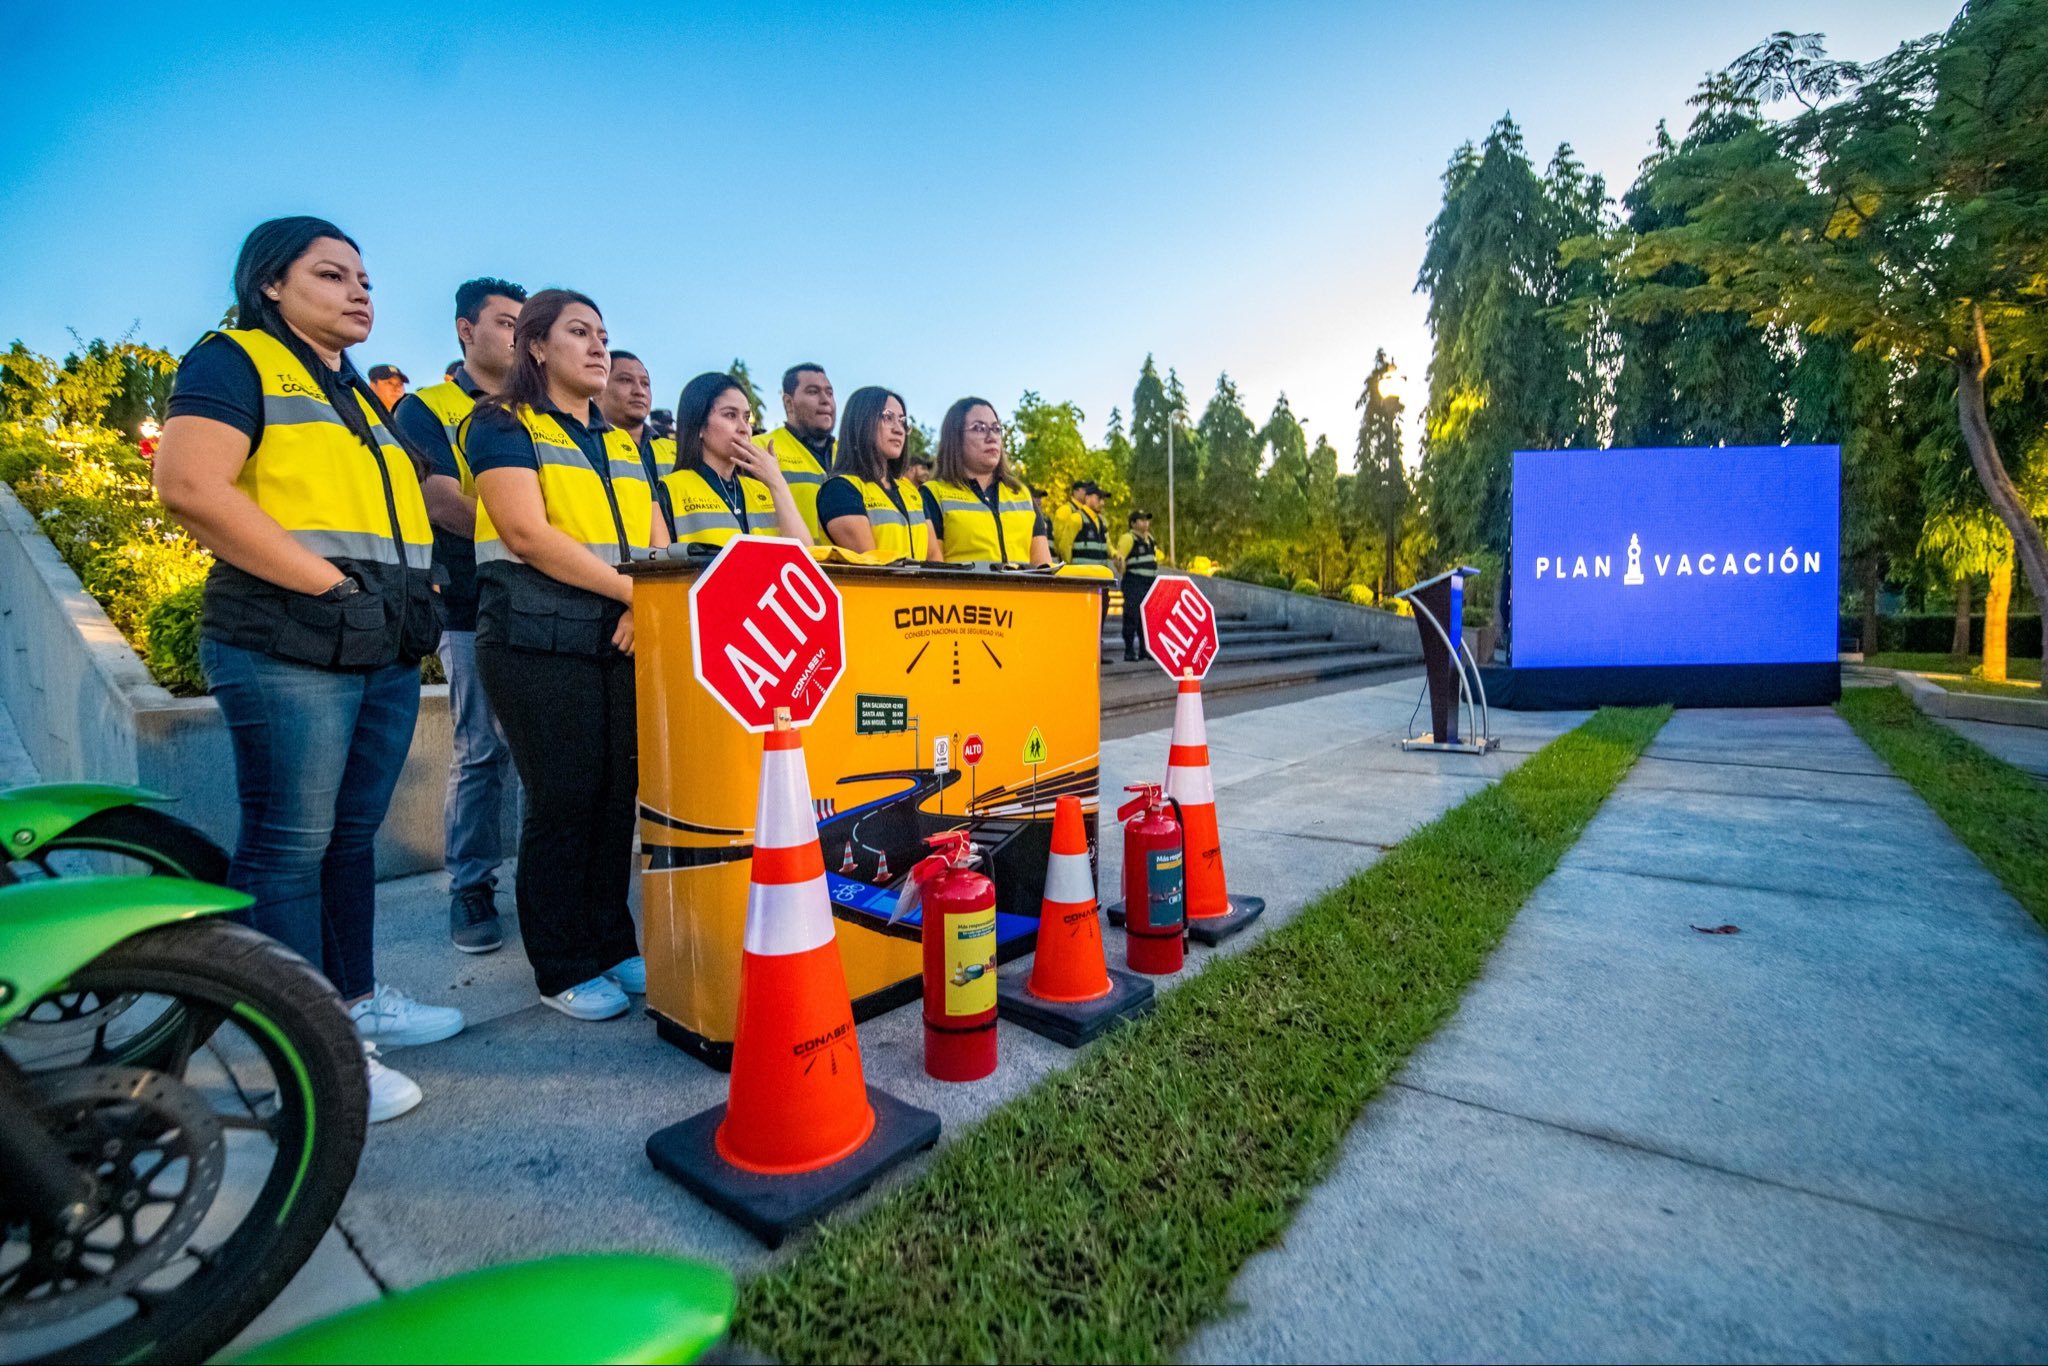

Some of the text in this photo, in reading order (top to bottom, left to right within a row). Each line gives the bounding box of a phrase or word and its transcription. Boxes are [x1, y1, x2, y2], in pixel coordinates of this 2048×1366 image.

[684, 503, 721, 512] CONASEVI
[1536, 546, 1821, 579] PLAN VACACIÓN
[894, 604, 1013, 629] CONASEVI
[1158, 588, 1207, 668] ALTO
[724, 562, 826, 709] ALTO
[904, 629, 931, 640] CONSEJO
[931, 627, 958, 636] NACIONAL
[959, 627, 966, 635] DE
[967, 628, 994, 636] SEGURIDAD
[791, 647, 826, 699] CONASEVI
[965, 744, 982, 755] ALTO
